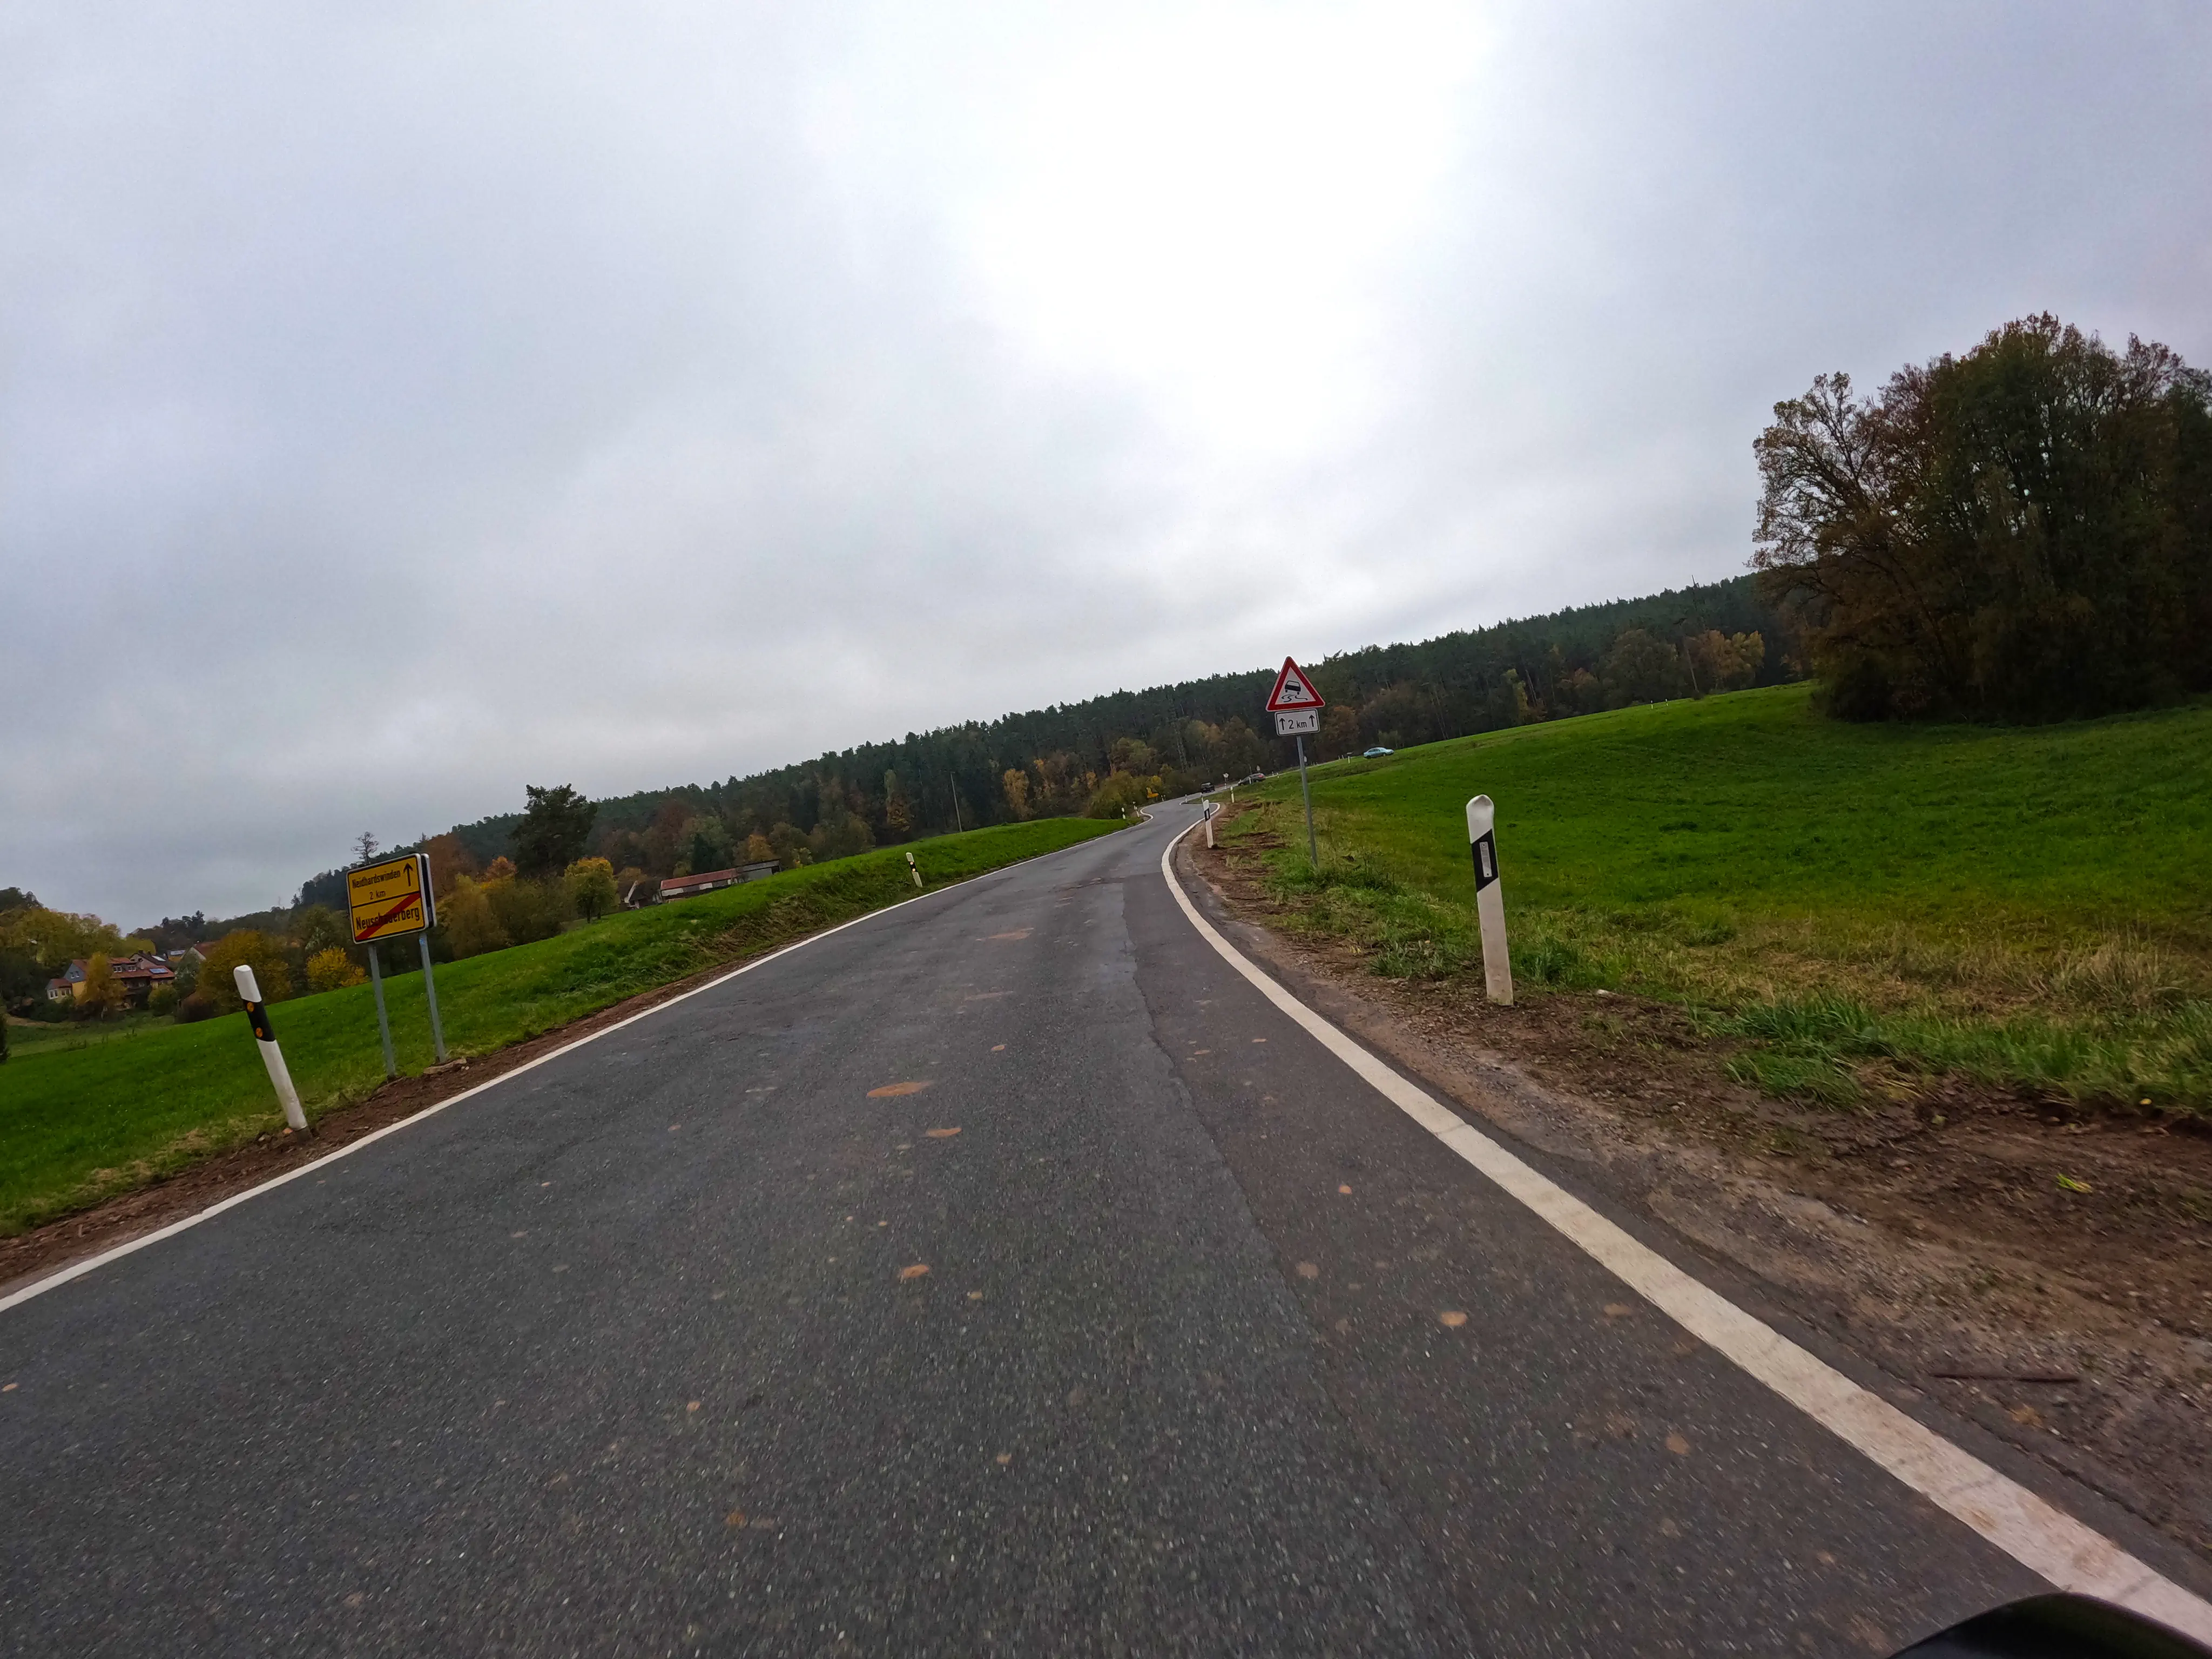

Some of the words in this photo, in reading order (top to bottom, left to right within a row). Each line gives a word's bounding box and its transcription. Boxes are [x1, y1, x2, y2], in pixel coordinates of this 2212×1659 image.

[1288, 720, 1294, 729] 2
[1297, 720, 1307, 729] km
[369, 892, 374, 900] 2
[376, 890, 386, 898] km
[356, 907, 420, 930] Neuschuerberg
